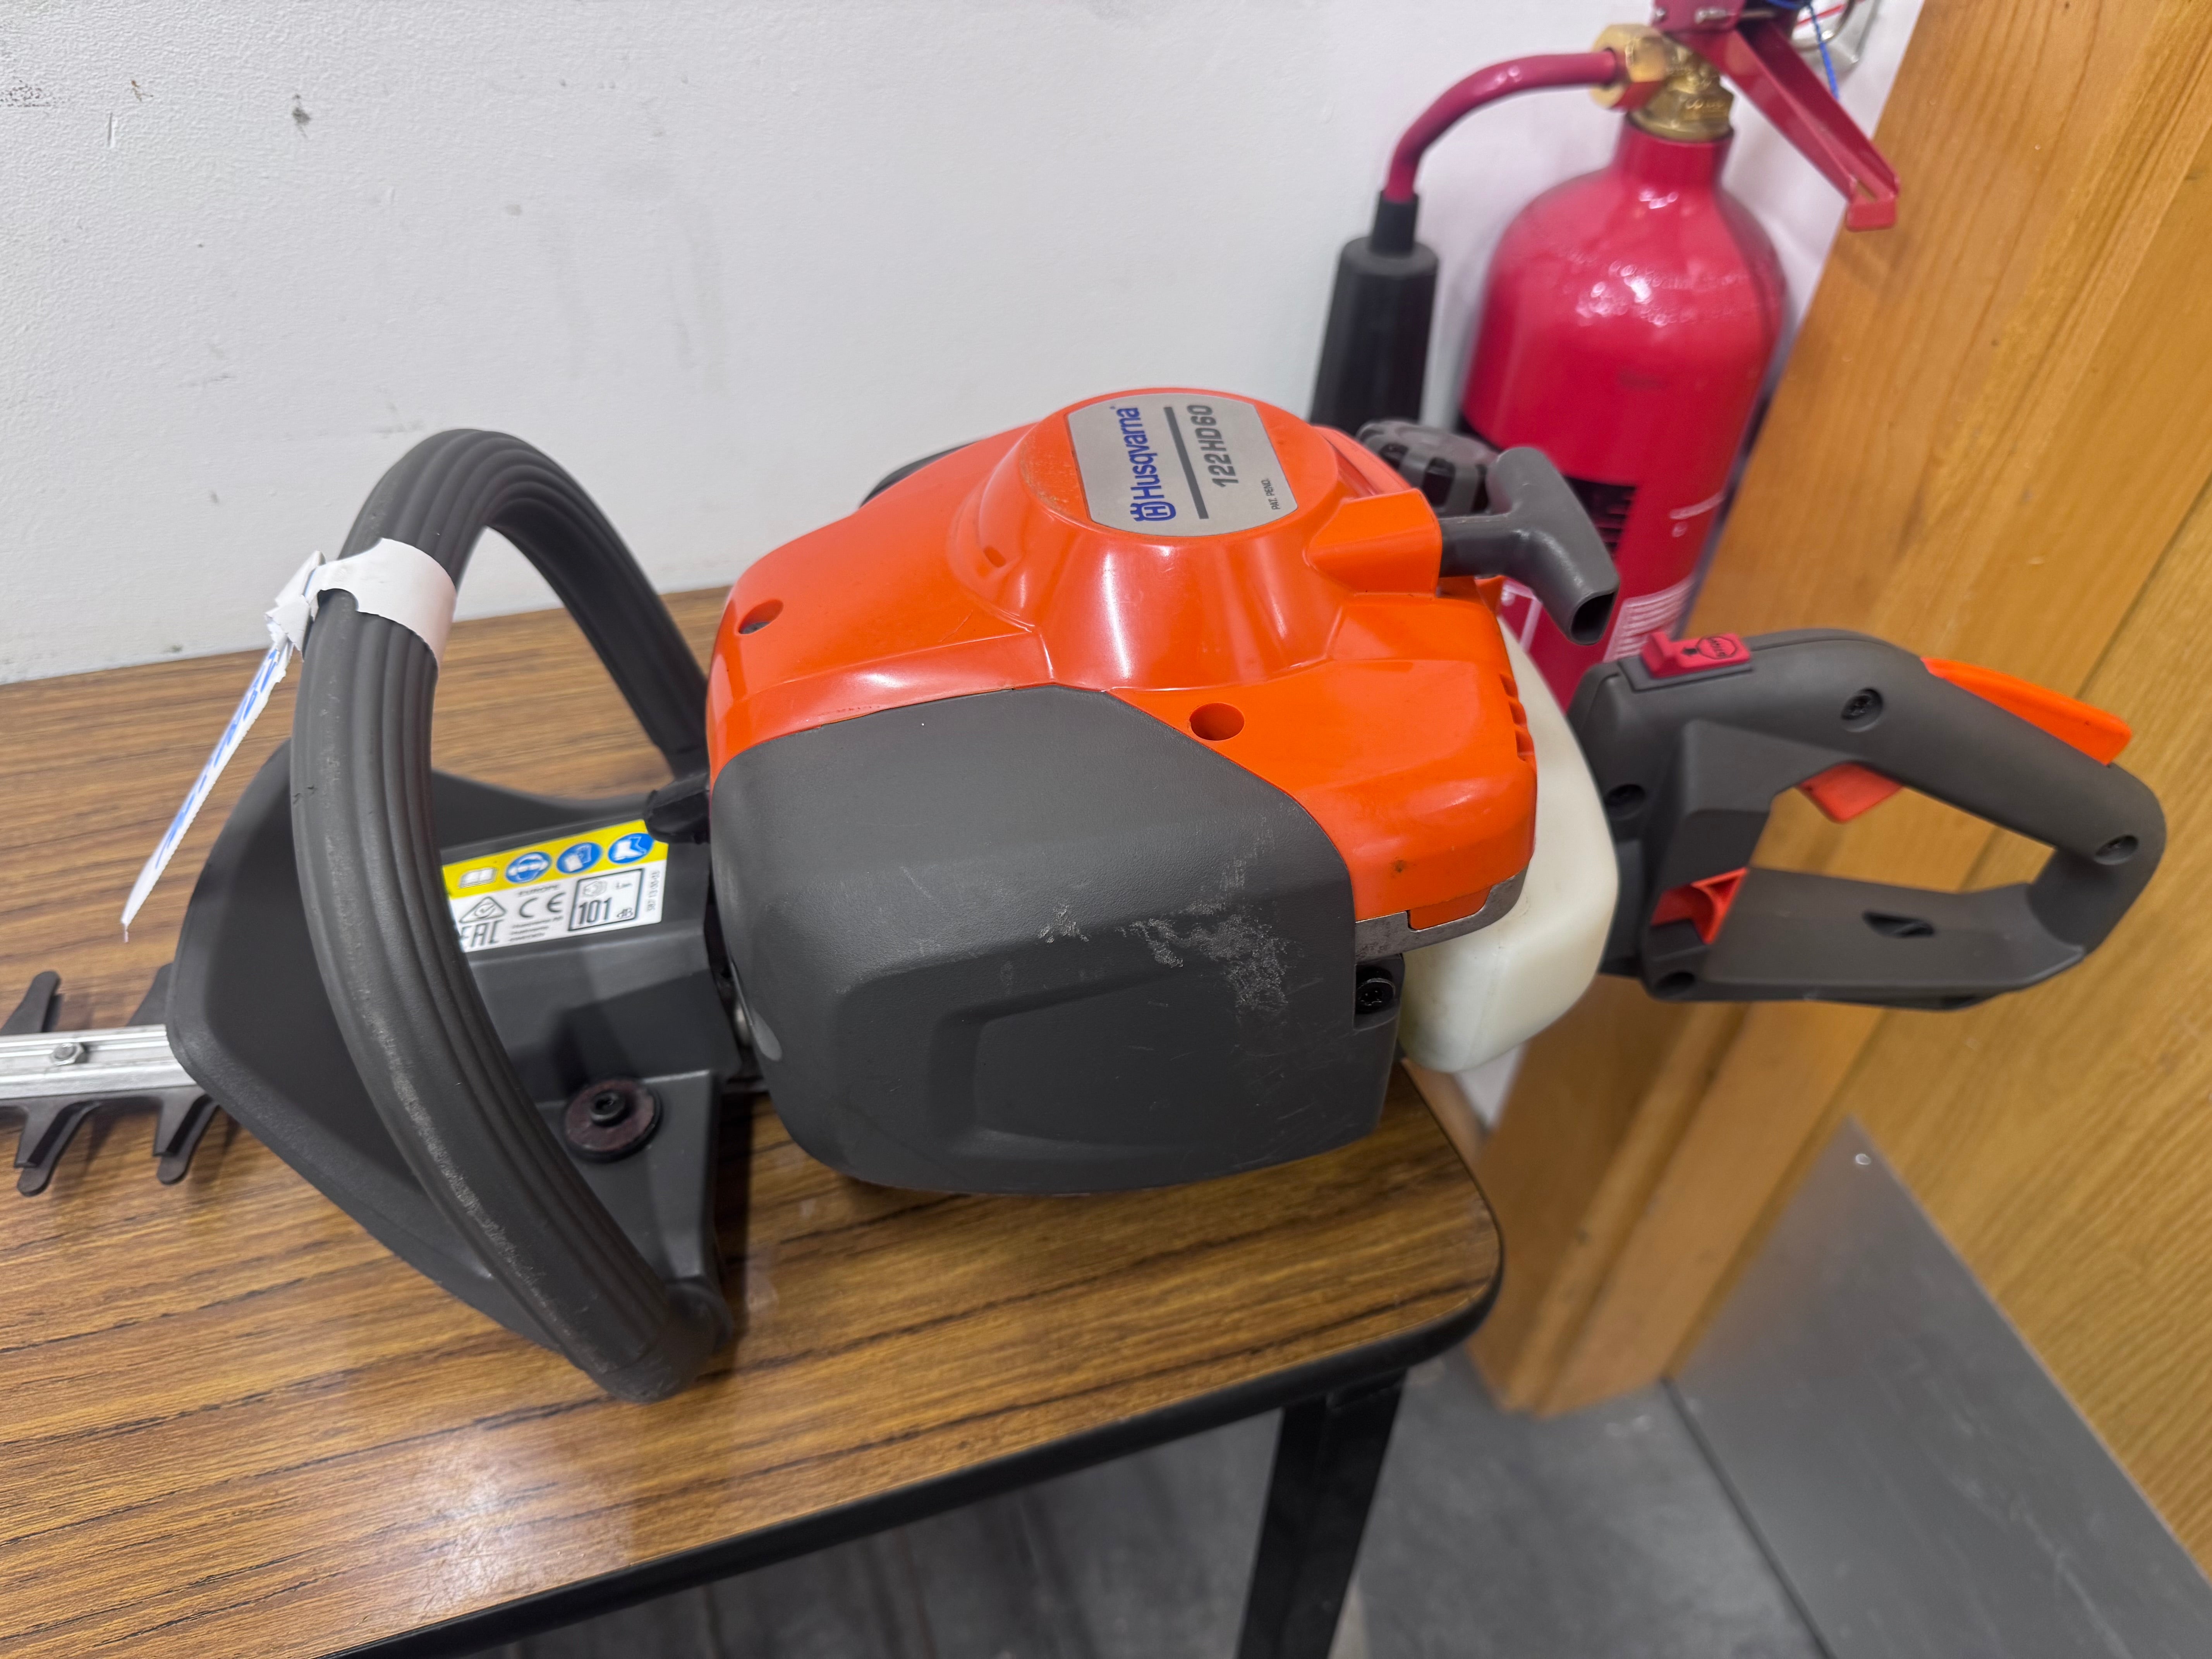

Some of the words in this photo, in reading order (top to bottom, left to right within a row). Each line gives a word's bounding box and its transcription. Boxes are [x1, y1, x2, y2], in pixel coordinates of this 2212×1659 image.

[1116, 408, 1165, 500] Husqvarna
[1261, 478, 1275, 496] PEND.
[1268, 498, 1281, 510] PAT.
[519, 891, 566, 918] CE
[579, 897, 612, 924] 101
